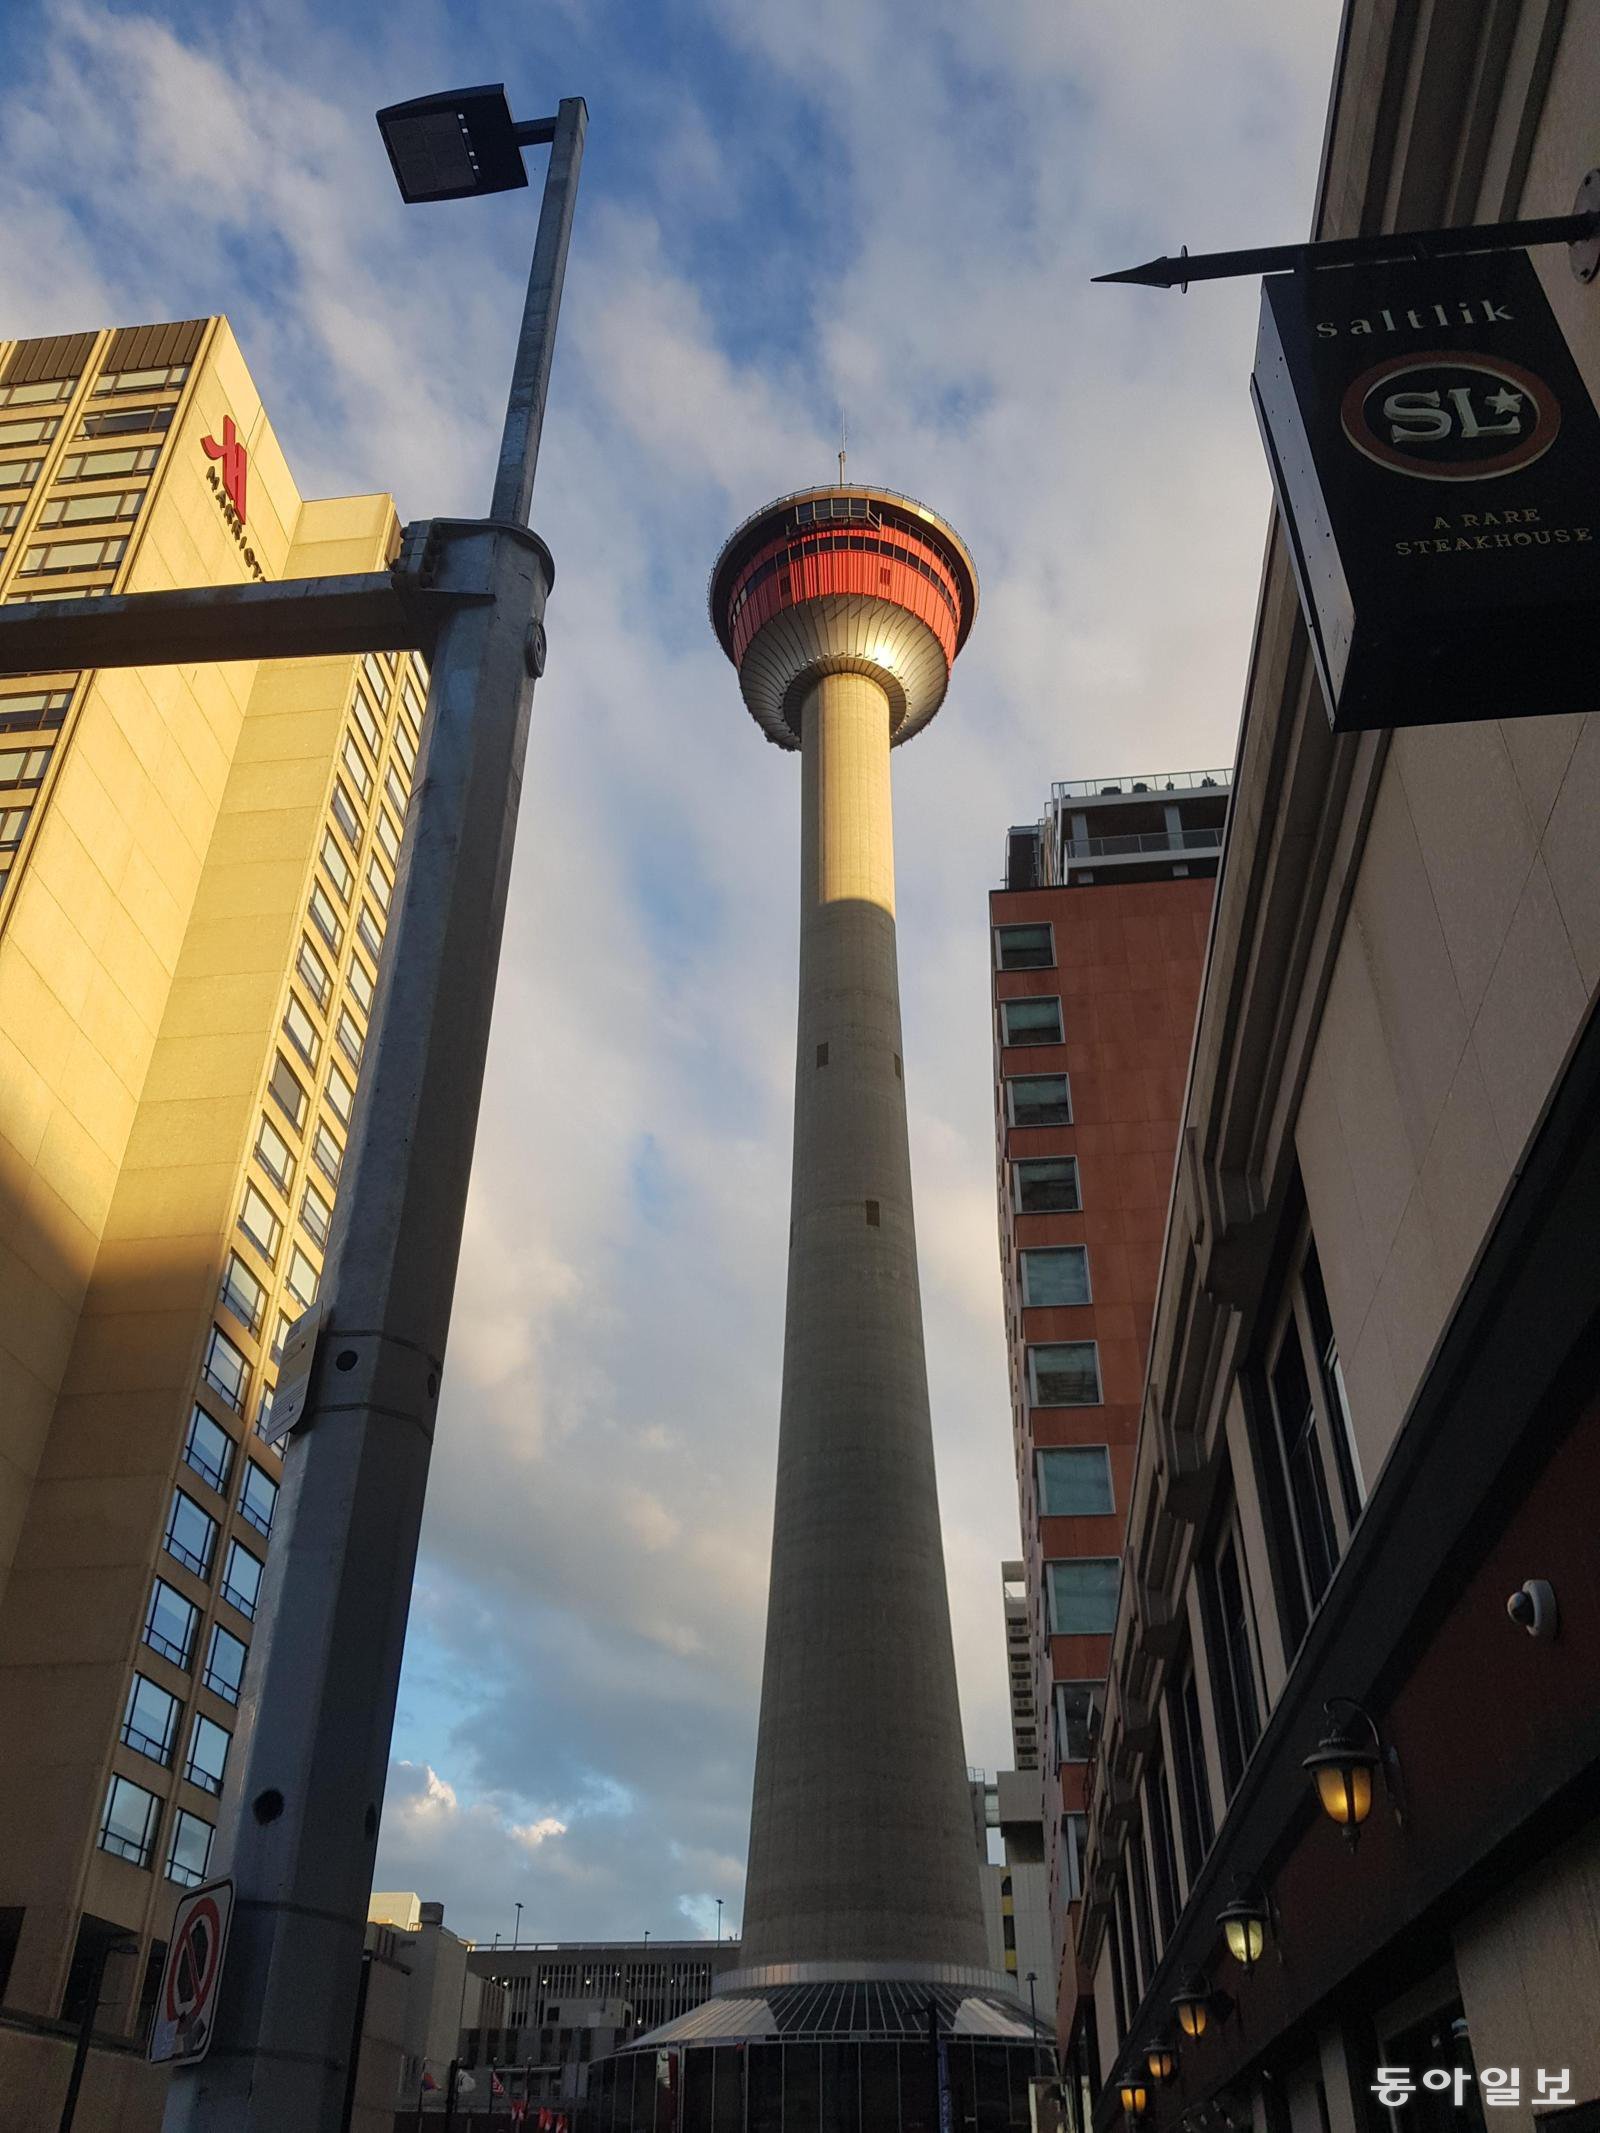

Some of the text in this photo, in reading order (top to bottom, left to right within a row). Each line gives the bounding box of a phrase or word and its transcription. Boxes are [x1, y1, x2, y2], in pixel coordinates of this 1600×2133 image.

[1315, 299, 1515, 339] saltlik
[1433, 508, 1541, 530] A RARE
[1395, 527, 1594, 556] STEAKHOUSE
